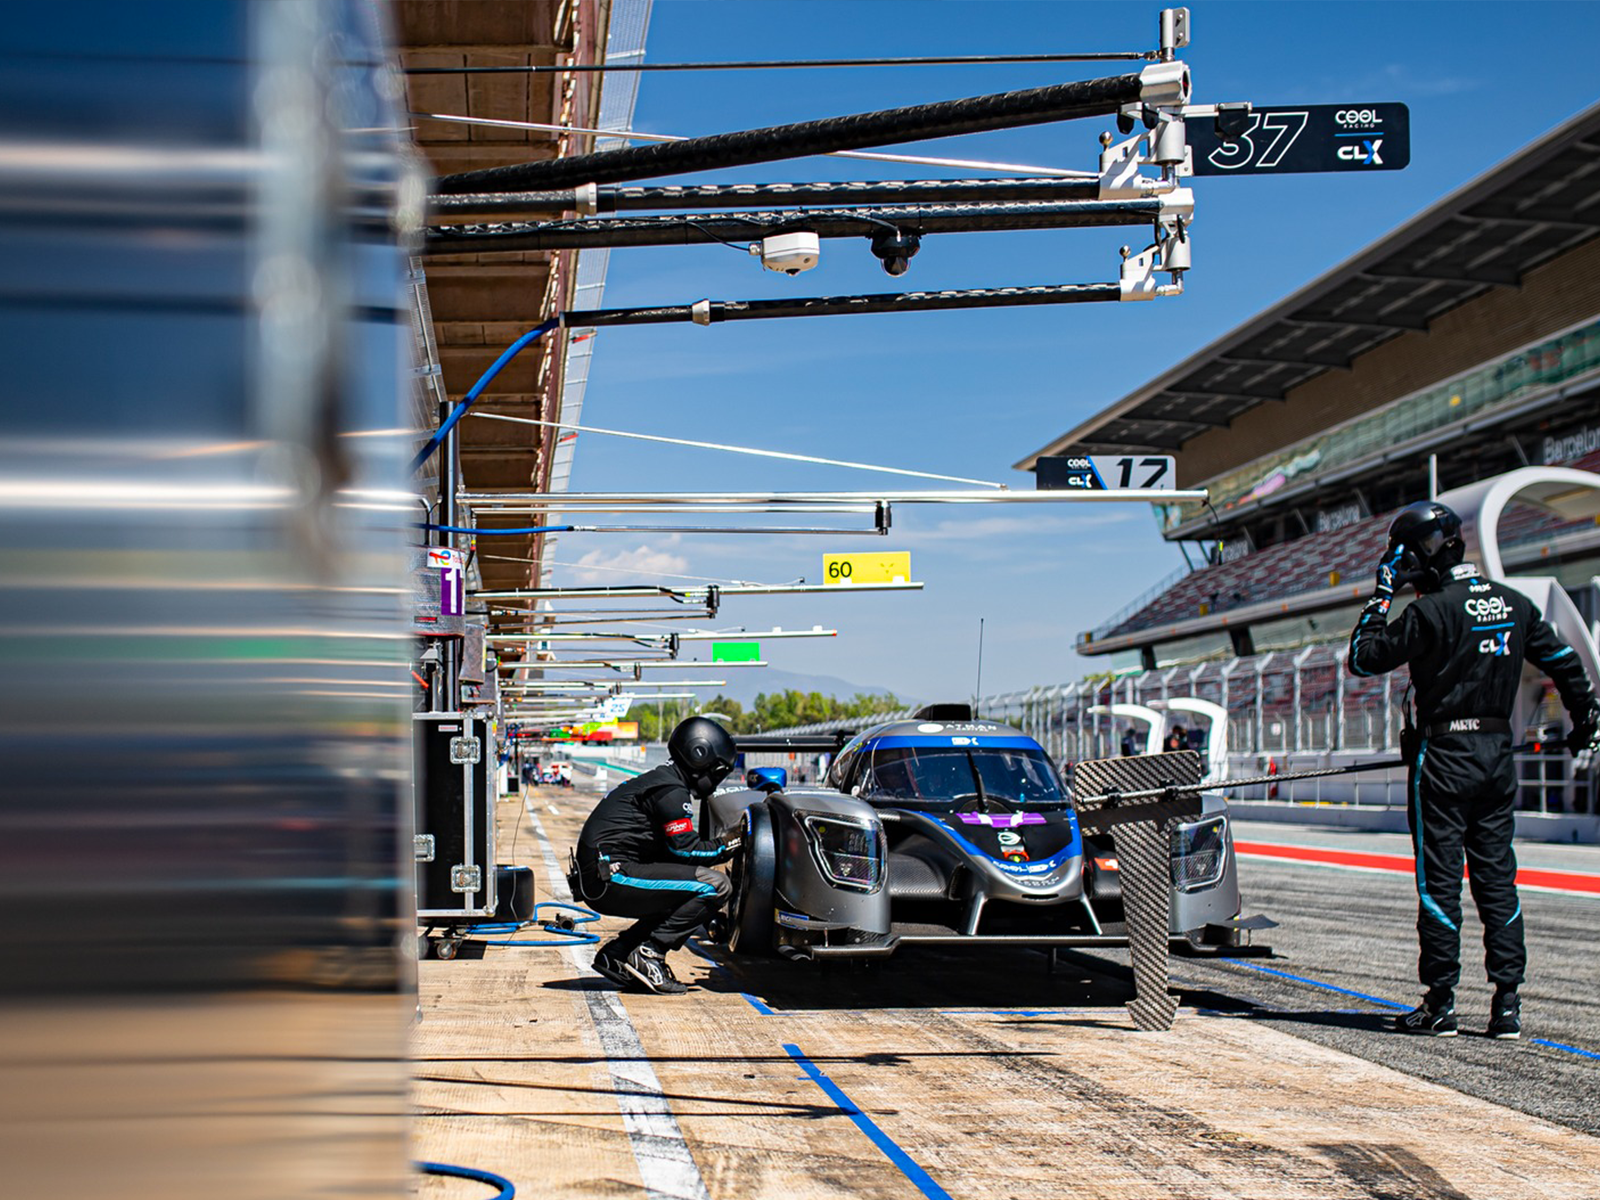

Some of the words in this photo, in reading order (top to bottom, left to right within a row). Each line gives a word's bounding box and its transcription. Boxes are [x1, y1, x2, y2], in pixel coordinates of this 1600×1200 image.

[1335, 109, 1383, 124] COOL
[1208, 112, 1309, 169] 37
[1337, 139, 1384, 165] CLX
[1067, 458, 1092, 468] COOL
[1116, 458, 1168, 488] 17
[1067, 474, 1092, 488] CLX
[828, 561, 853, 578] 60
[444, 568, 458, 614] 1
[1464, 596, 1513, 616] COOL
[1478, 631, 1512, 656] CLX
